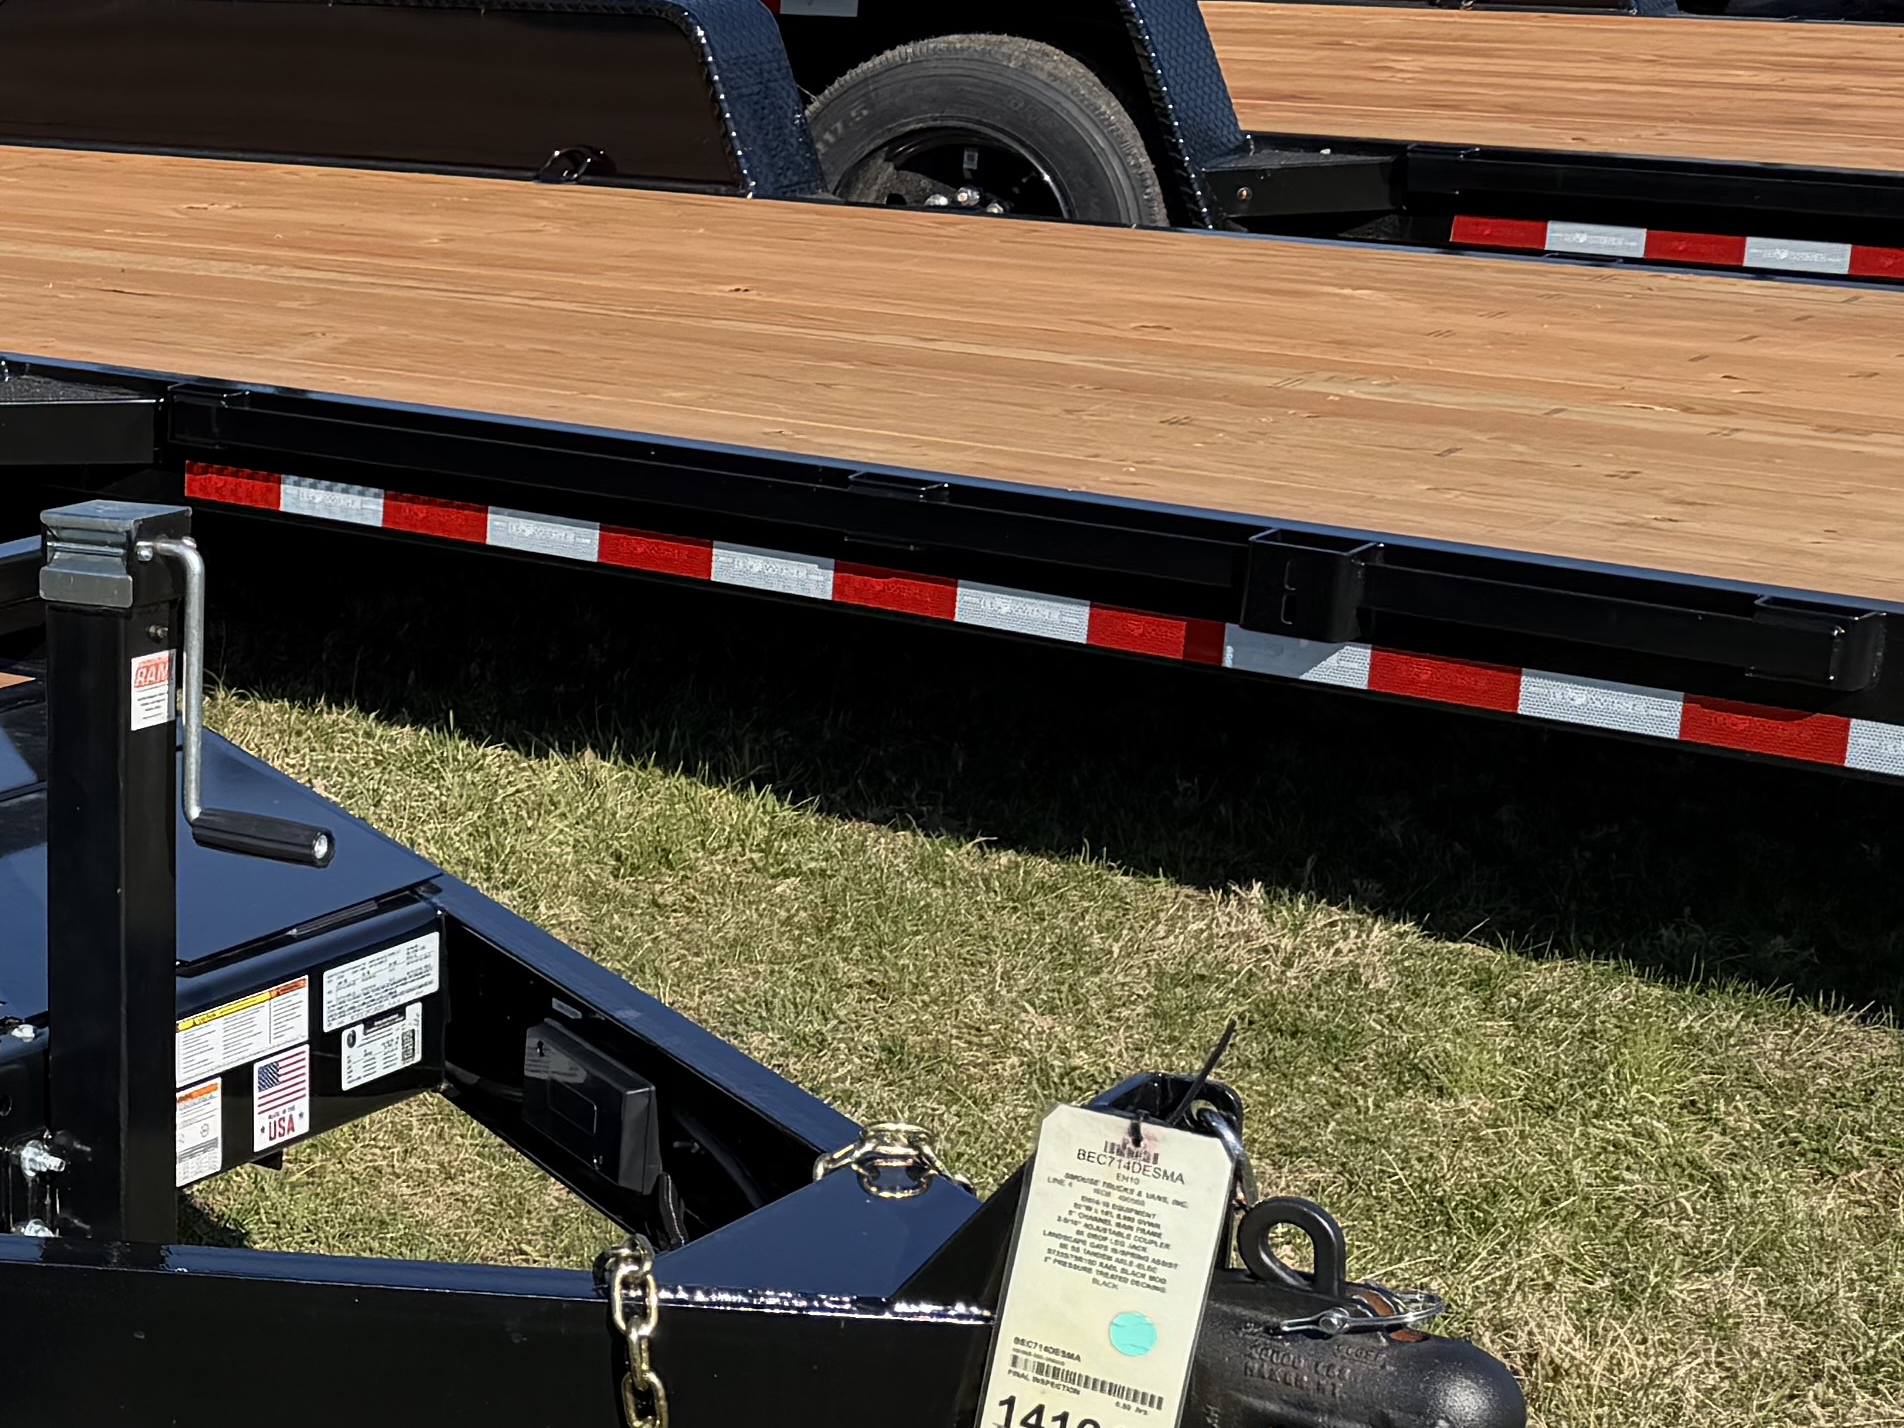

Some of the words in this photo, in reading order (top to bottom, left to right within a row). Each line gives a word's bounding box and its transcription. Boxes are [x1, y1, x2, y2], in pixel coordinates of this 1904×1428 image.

[269, 1113, 295, 1141] USA
[1077, 1148, 1185, 1184] BEC714DESMA
[1042, 1229, 1087, 1247] LANDSCAPE
[1083, 1222, 1131, 1240] ADJUSTABLE
[1134, 1234, 1171, 1250] COUPLER
[1053, 1259, 1093, 1274] PRESSURE
[1095, 1269, 1129, 1284] TREATED
[1092, 1277, 1119, 1290] BLACK
[1013, 1336, 1081, 1363] BEC714DESMA
[1007, 1369, 1030, 1383] FINAL
[1032, 1376, 1081, 1396] INSPECTION
